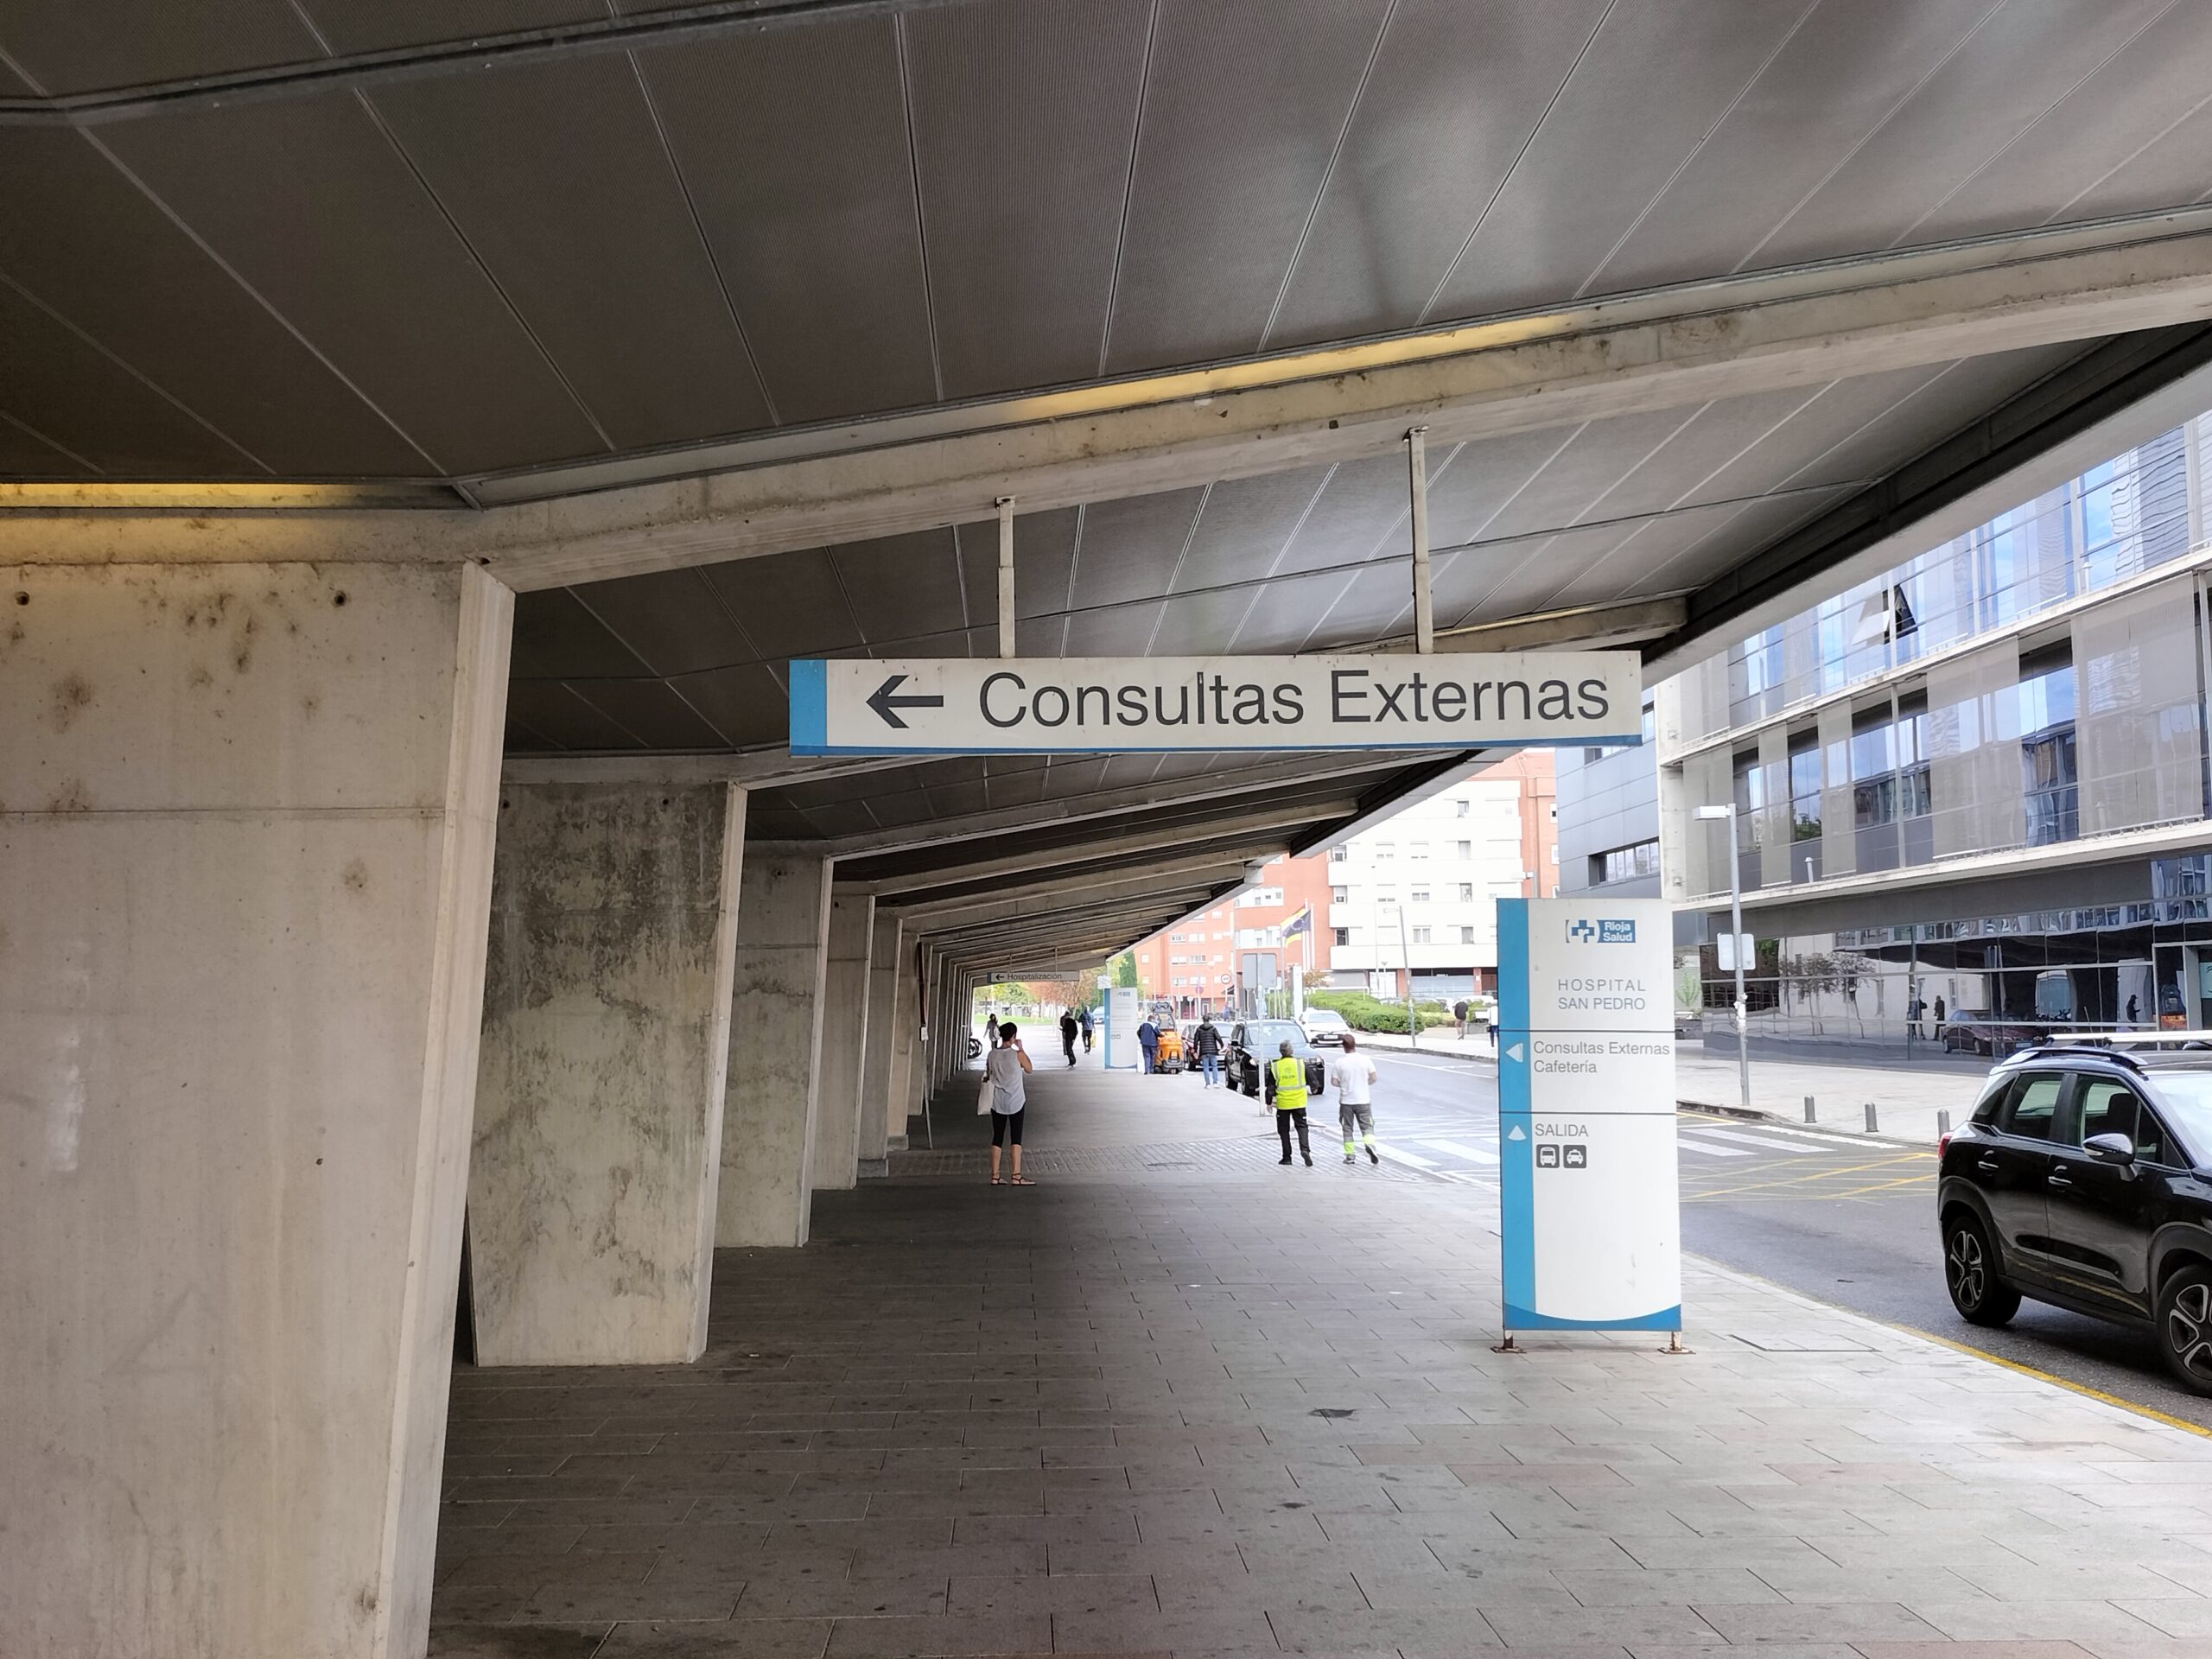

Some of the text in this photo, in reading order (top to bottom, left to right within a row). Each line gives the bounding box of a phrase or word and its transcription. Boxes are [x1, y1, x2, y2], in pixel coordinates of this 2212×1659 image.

[979, 670, 1610, 727] Consultas Externas
[1605, 921, 1631, 932] Rioja
[1603, 932, 1633, 942] Salud
[1007, 973, 1062, 982] Hospitalización
[1558, 979, 1645, 992] HOSPITAL
[1558, 998, 1645, 1010] SAN PEDRO
[1534, 1041, 1670, 1055] Consultas Externas
[1534, 1060, 1597, 1073] Cafetería
[1535, 1123, 1588, 1137] SALIDA
